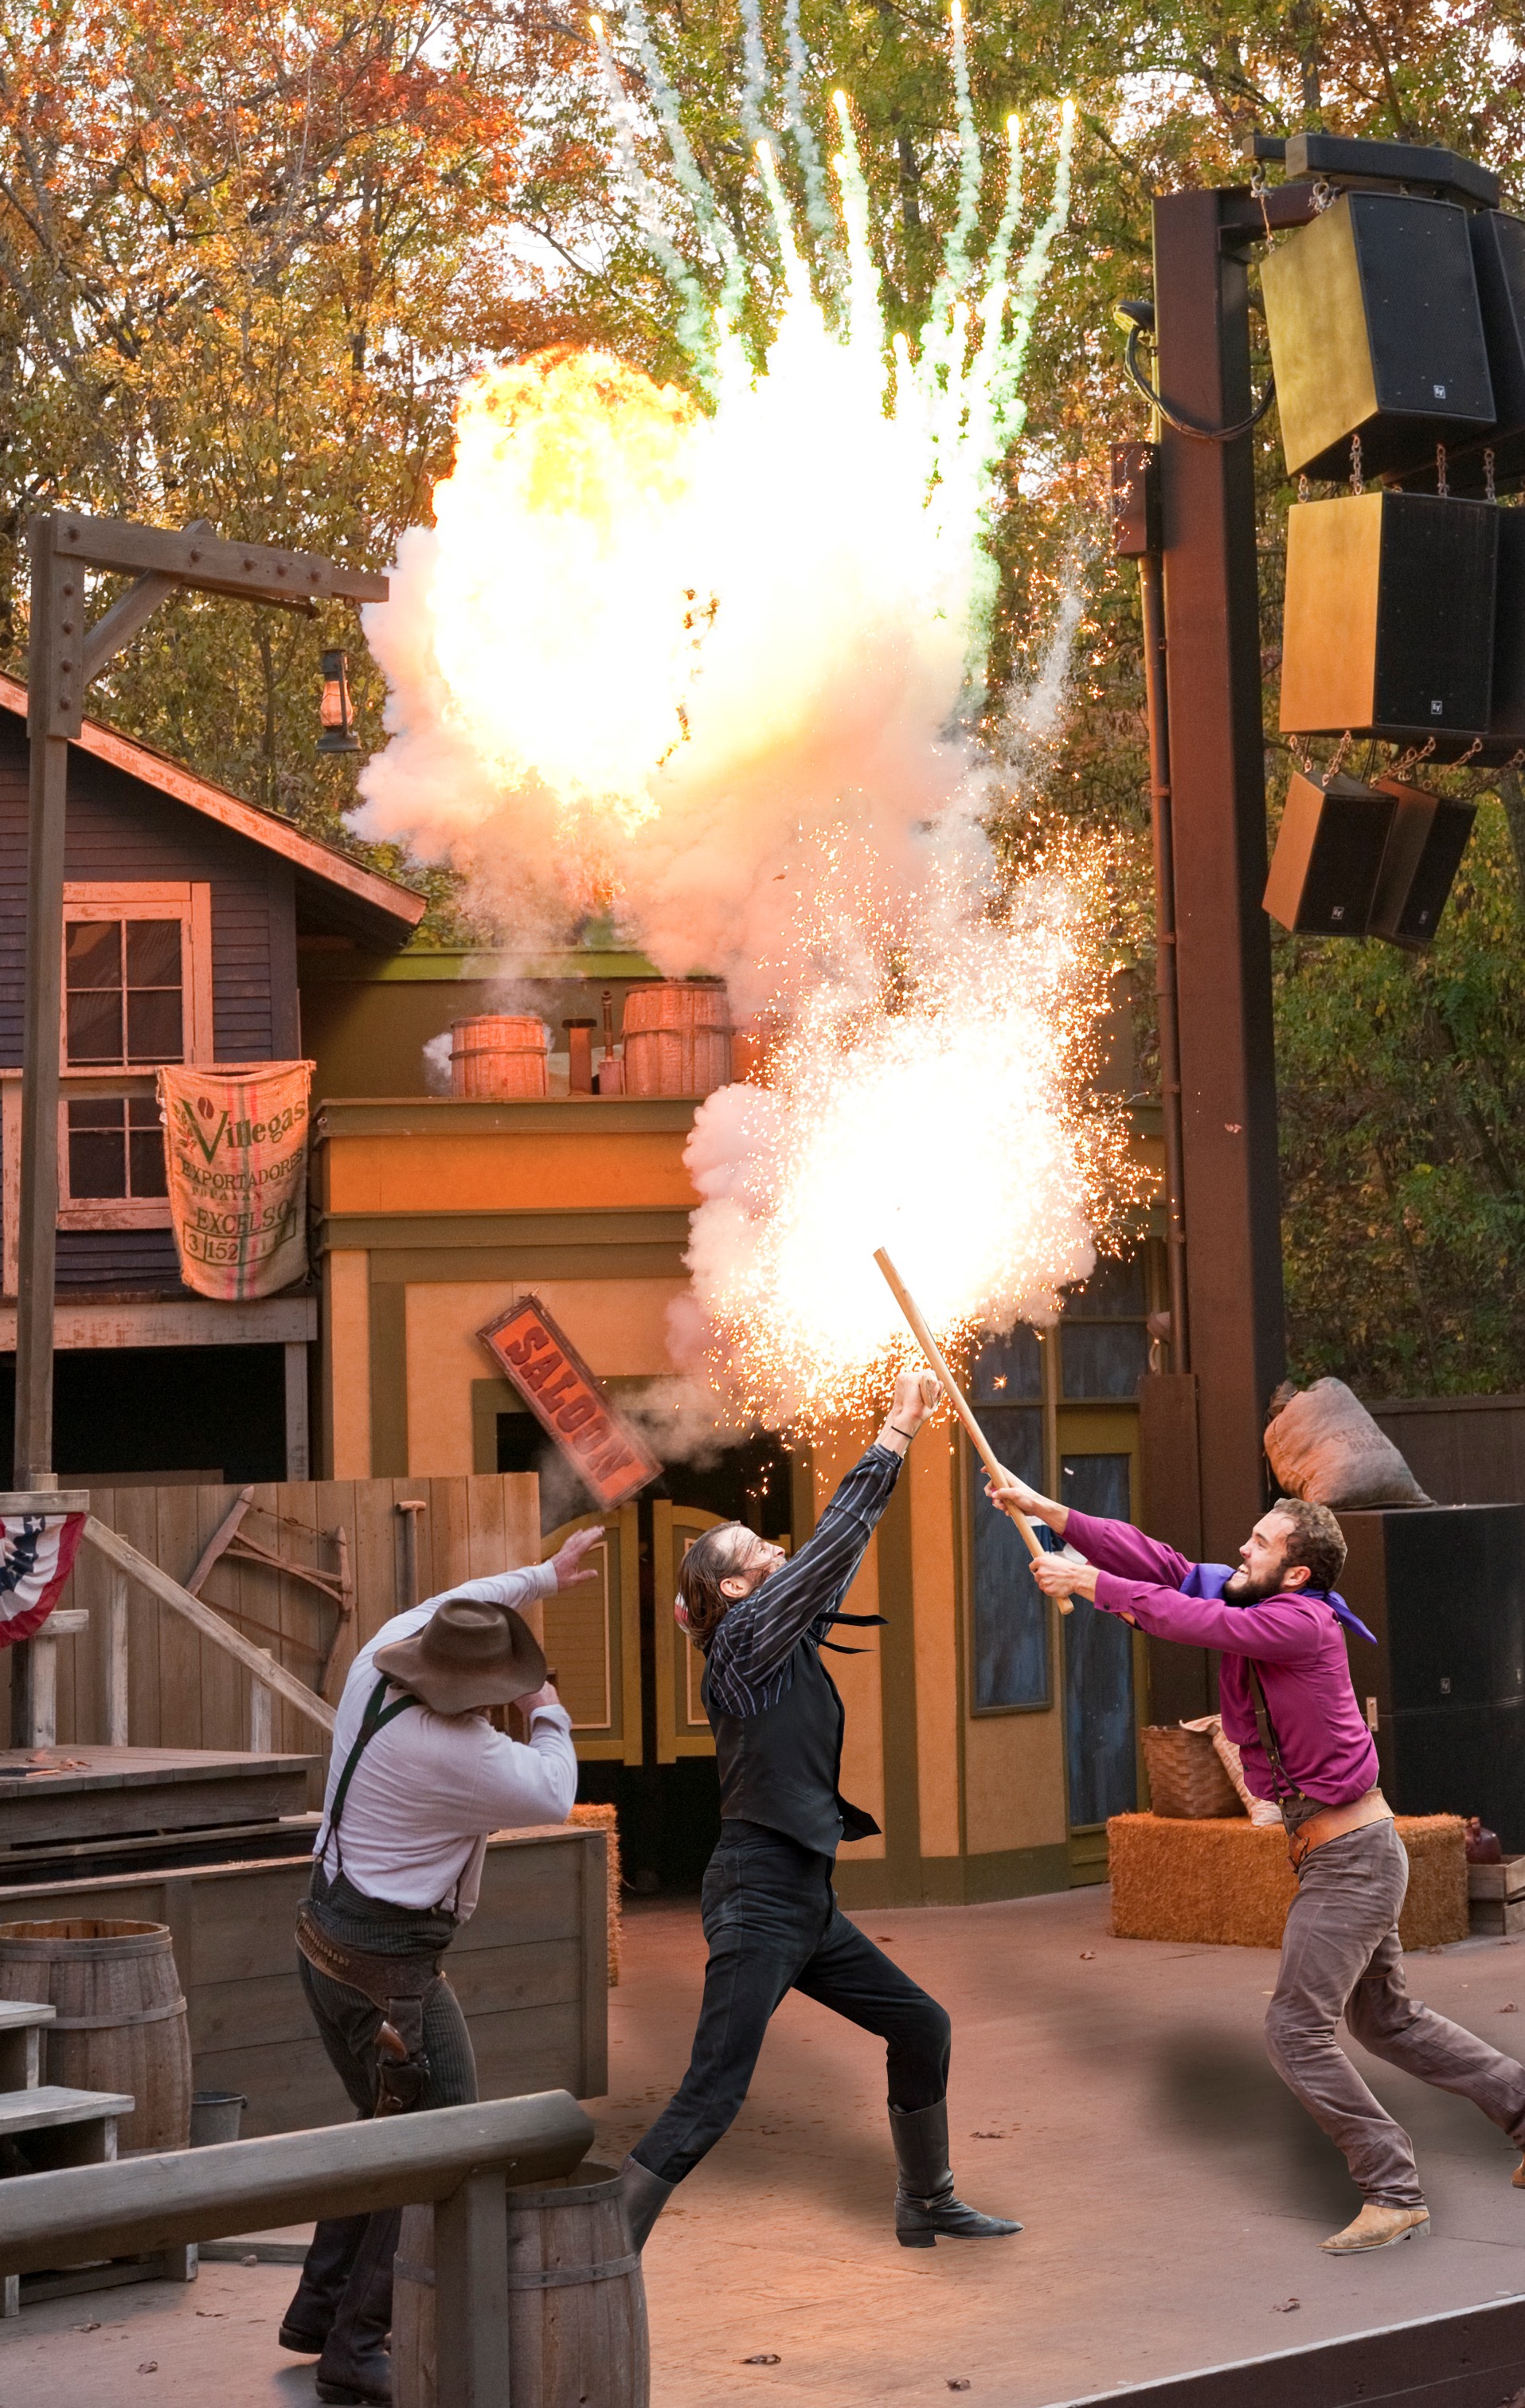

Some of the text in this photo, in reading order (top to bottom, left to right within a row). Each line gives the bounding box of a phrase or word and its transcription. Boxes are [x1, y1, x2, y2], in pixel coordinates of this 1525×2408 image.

[179, 1098, 306, 1164] Villegas
[182, 1149, 304, 1188] EXPORTADORES
[196, 1199, 290, 1235] EXCELSO
[189, 1234, 198, 1251] 3
[207, 1241, 239, 1261] 152
[504, 1325, 635, 1482] SALOON
